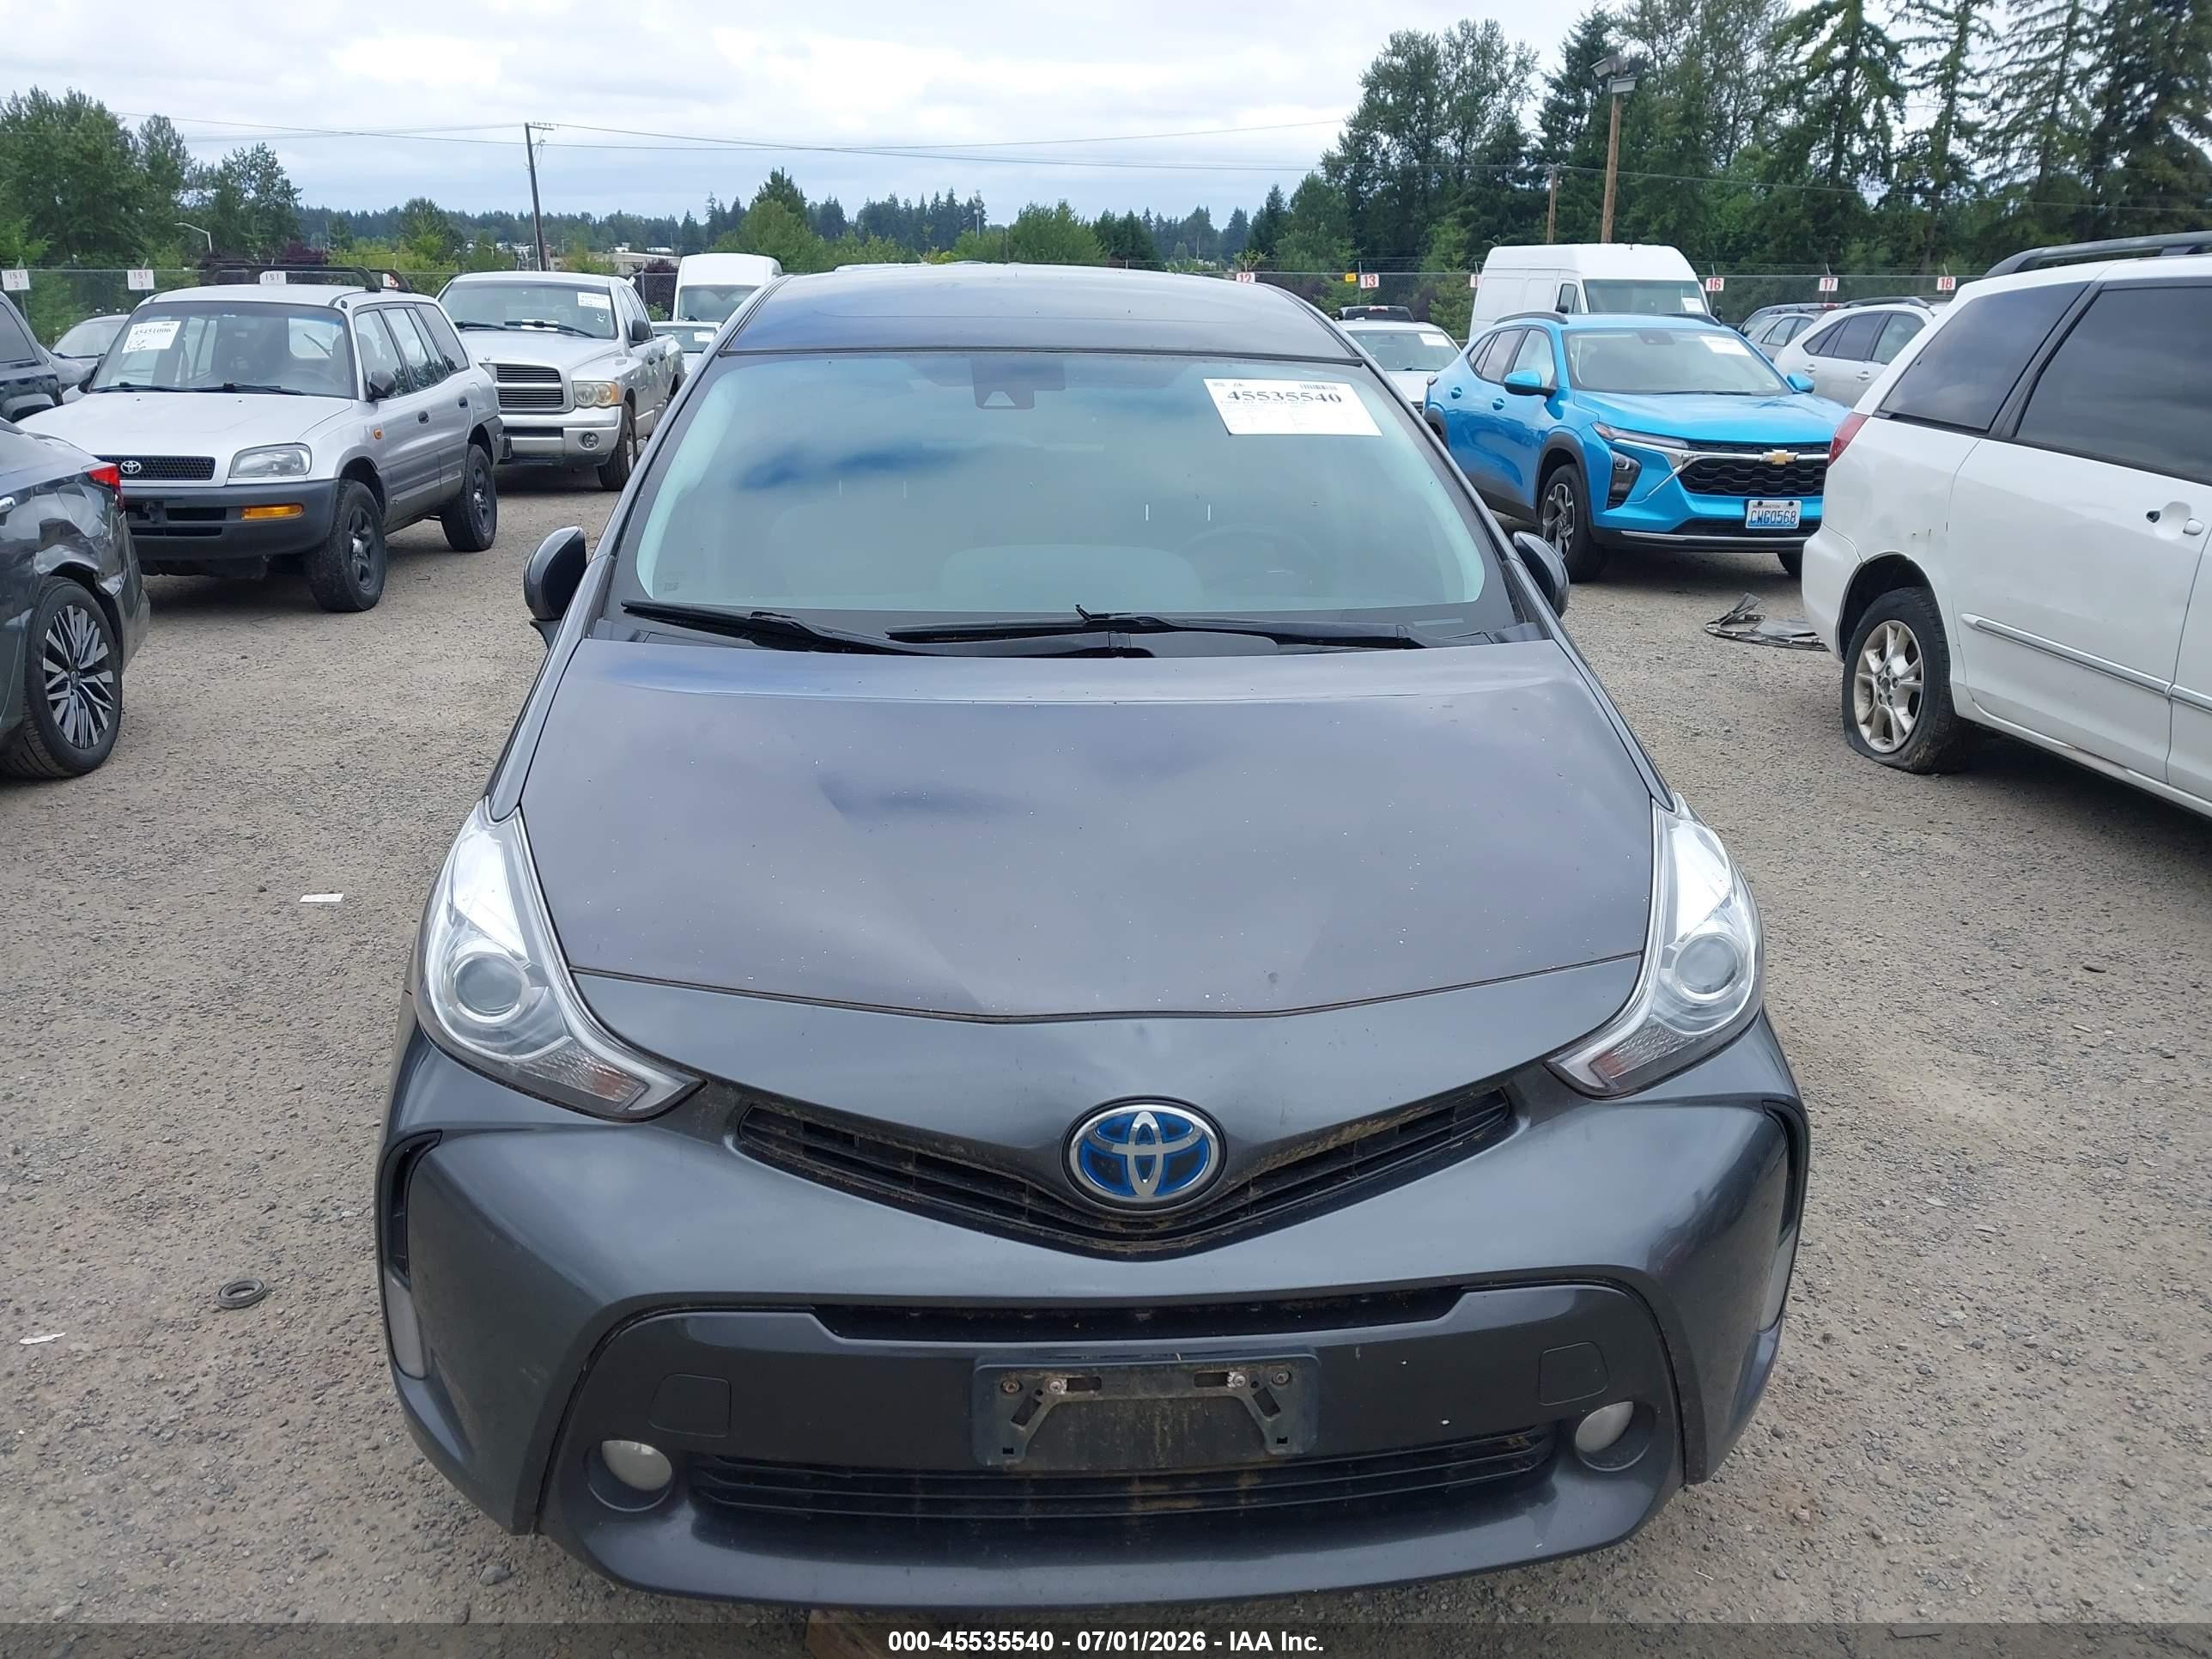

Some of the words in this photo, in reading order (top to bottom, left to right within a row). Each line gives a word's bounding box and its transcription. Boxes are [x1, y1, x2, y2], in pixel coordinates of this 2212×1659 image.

[1240, 274, 1251, 283] 12
[1364, 275, 1376, 286] 13
[1941, 278, 1952, 289] 18
[1710, 279, 1721, 290] 16
[1824, 279, 1835, 290] 17
[1228, 392, 1342, 403] 45535540
[1751, 510, 1797, 524] CWG0568
